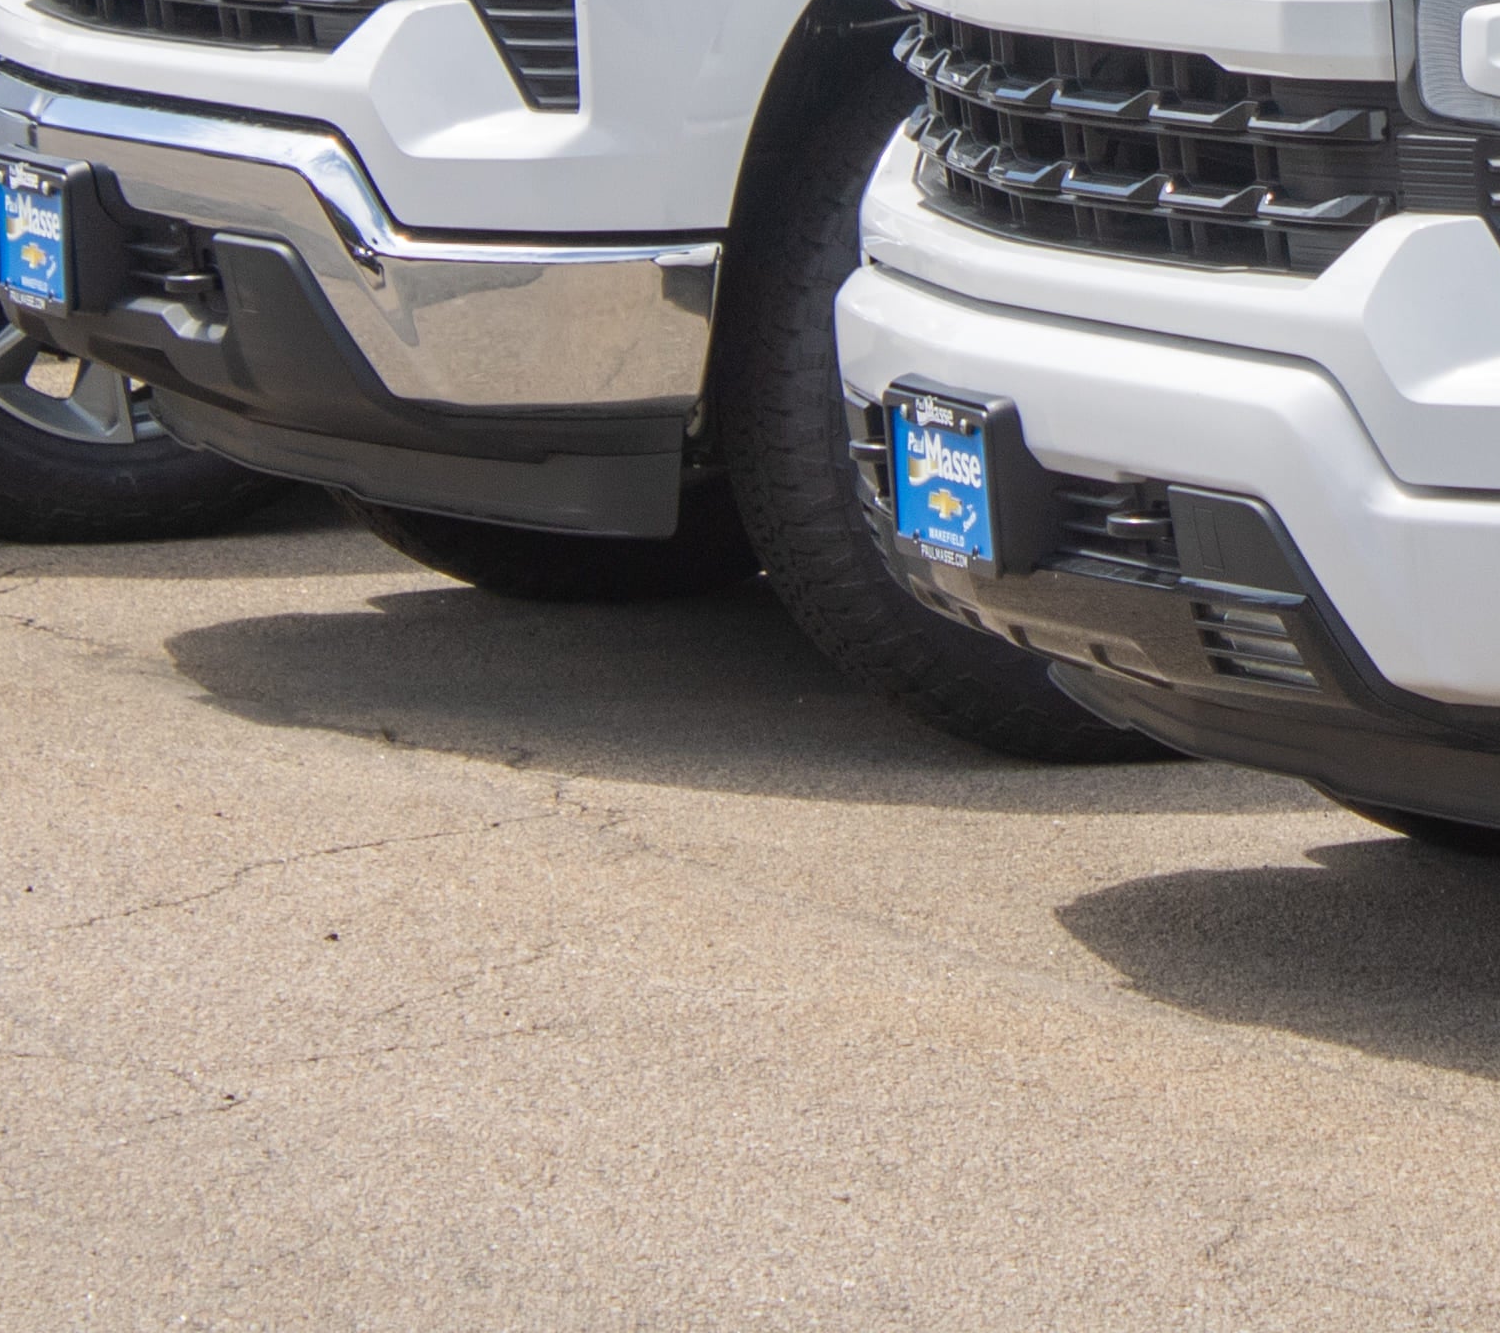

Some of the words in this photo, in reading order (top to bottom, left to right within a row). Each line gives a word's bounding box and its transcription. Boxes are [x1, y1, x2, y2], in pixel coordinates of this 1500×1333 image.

[17, 192, 60, 241] Masse
[924, 397, 954, 427] Masse
[907, 431, 924, 454] Paul
[924, 429, 981, 488] Masse
